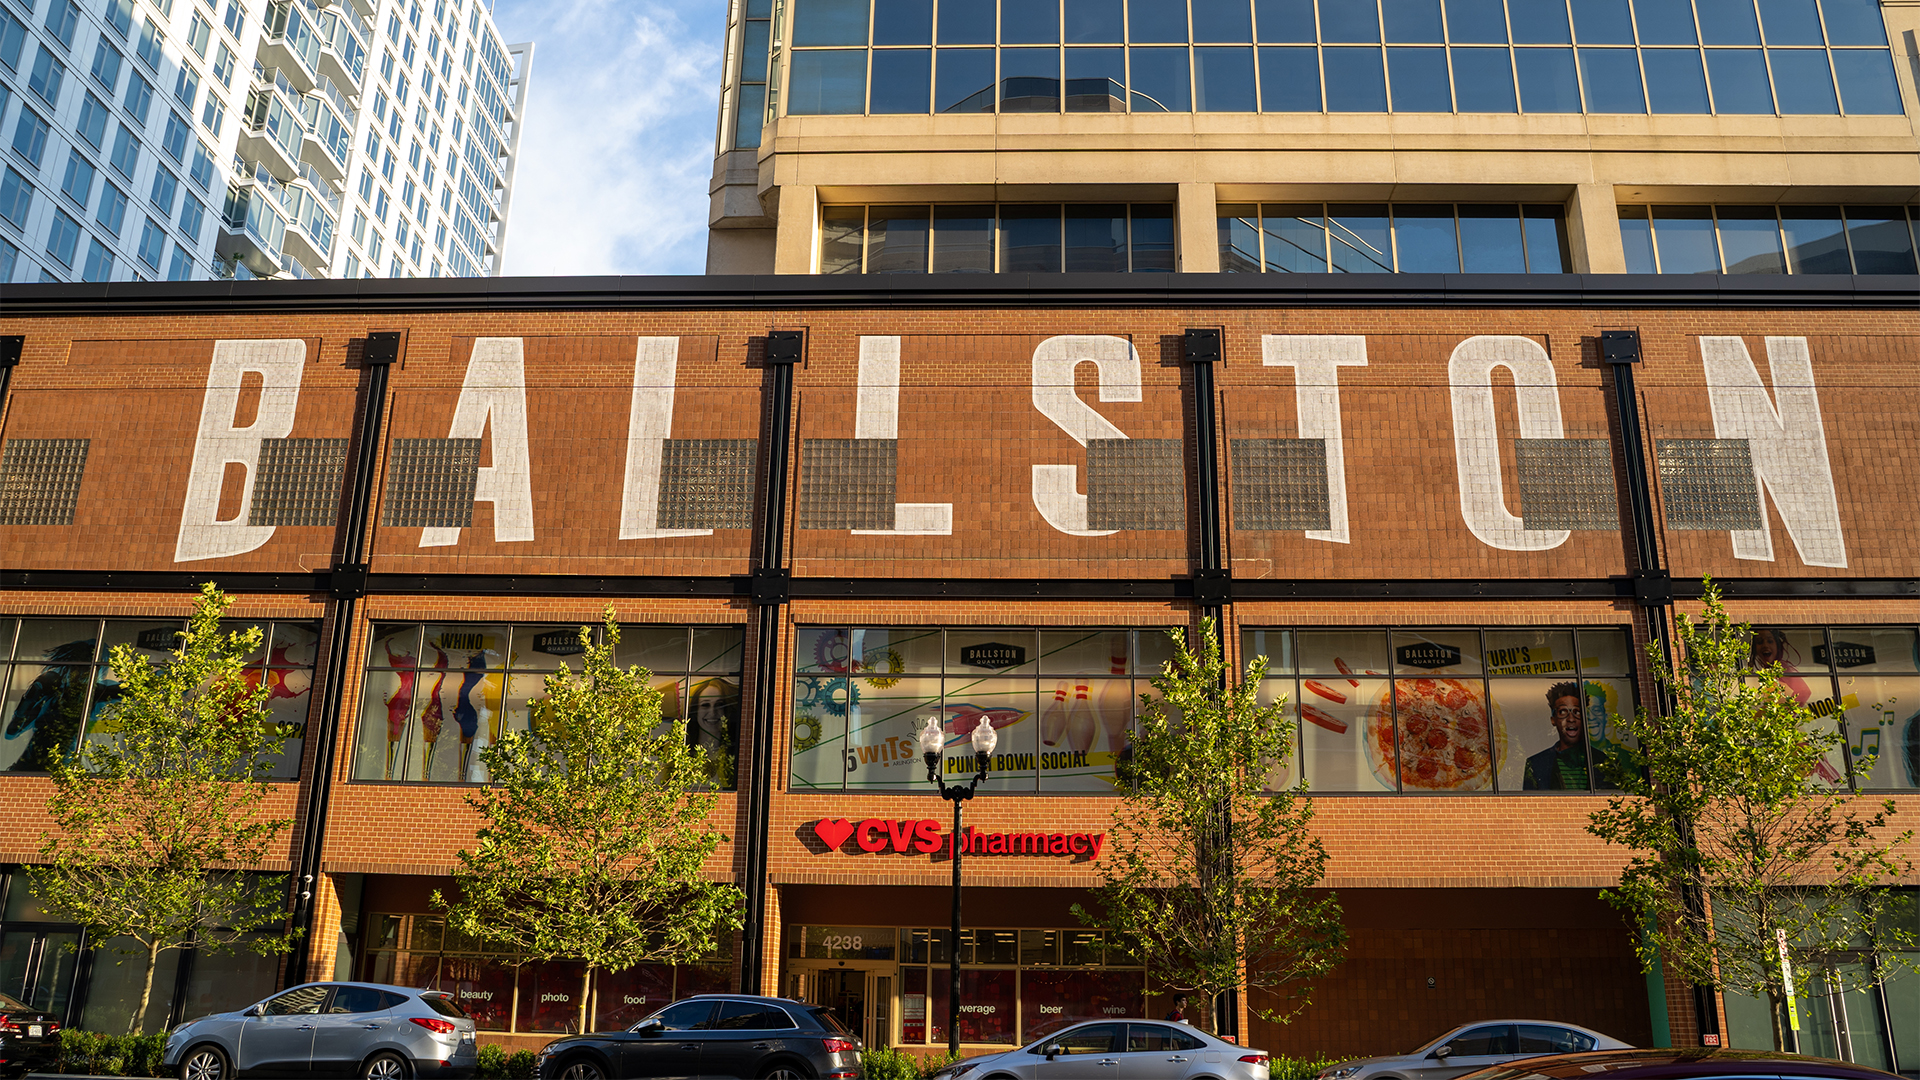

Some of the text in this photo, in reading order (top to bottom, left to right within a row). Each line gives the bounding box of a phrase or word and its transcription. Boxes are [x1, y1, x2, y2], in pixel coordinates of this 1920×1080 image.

[174, 334, 1848, 569] BALLSTON
[441, 633, 483, 649] WHINO
[541, 636, 581, 646] BALLSTO
[969, 649, 1017, 659] BALLSTON
[1405, 649, 1452, 658] BALLSTON
[1820, 648, 1867, 658] BLLSTON
[1534, 661, 1558, 674] PIZZA
[1559, 659, 1574, 671] CO.
[1808, 696, 1835, 719] NOO
[892, 757, 922, 767] ARLINGTON
[997, 753, 1035, 772] BOWL
[1042, 750, 1090, 770] SOCIAL
[857, 818, 1106, 860] CVS pharmacy
[822, 935, 863, 950] 4238
[460, 989, 493, 1000] beauty
[541, 992, 569, 1003] photo
[624, 995, 646, 1004] food
[1040, 1004, 1063, 1014] beer
[1103, 1005, 1126, 1014] wine
